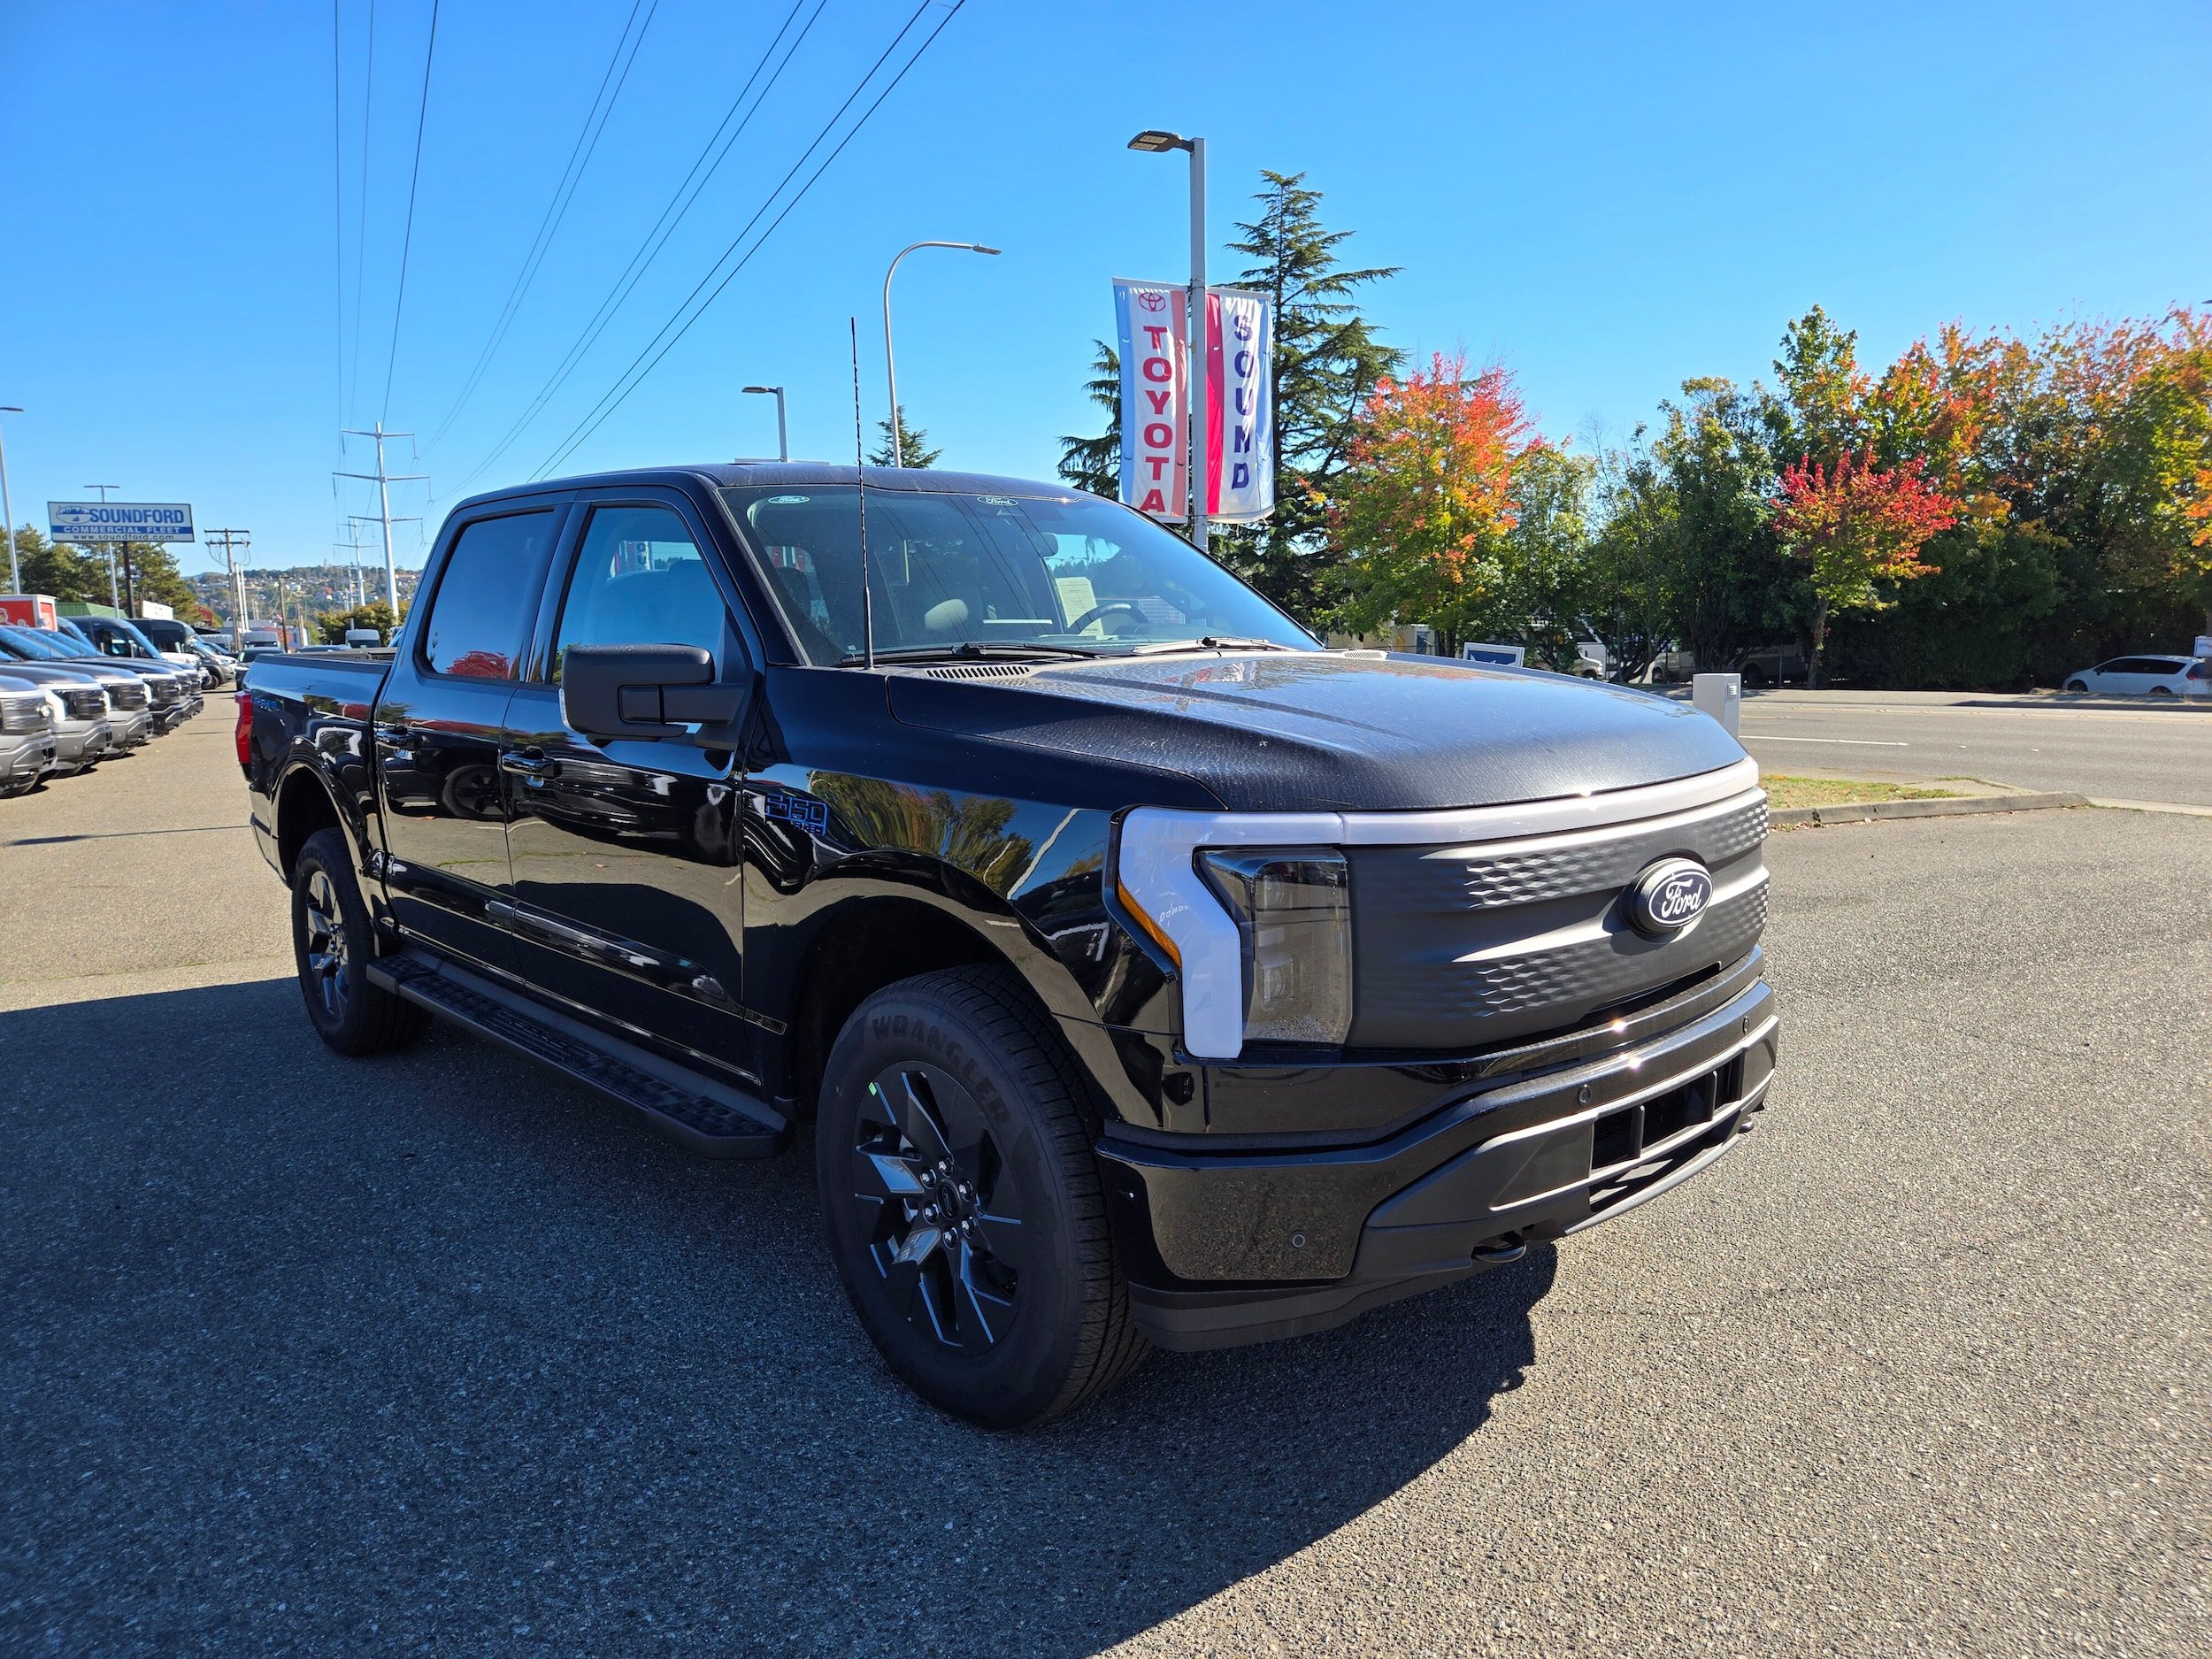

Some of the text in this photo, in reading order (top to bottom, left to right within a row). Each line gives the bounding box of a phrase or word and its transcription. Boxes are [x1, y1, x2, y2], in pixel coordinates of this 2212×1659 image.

[1140, 326, 1172, 512] TOYOTA
[1231, 314, 1254, 490] SOUND
[89, 508, 184, 524] SOUNDFORD
[1661, 878, 1704, 918] Ford
[872, 1015, 1010, 1127] WRANGLER
